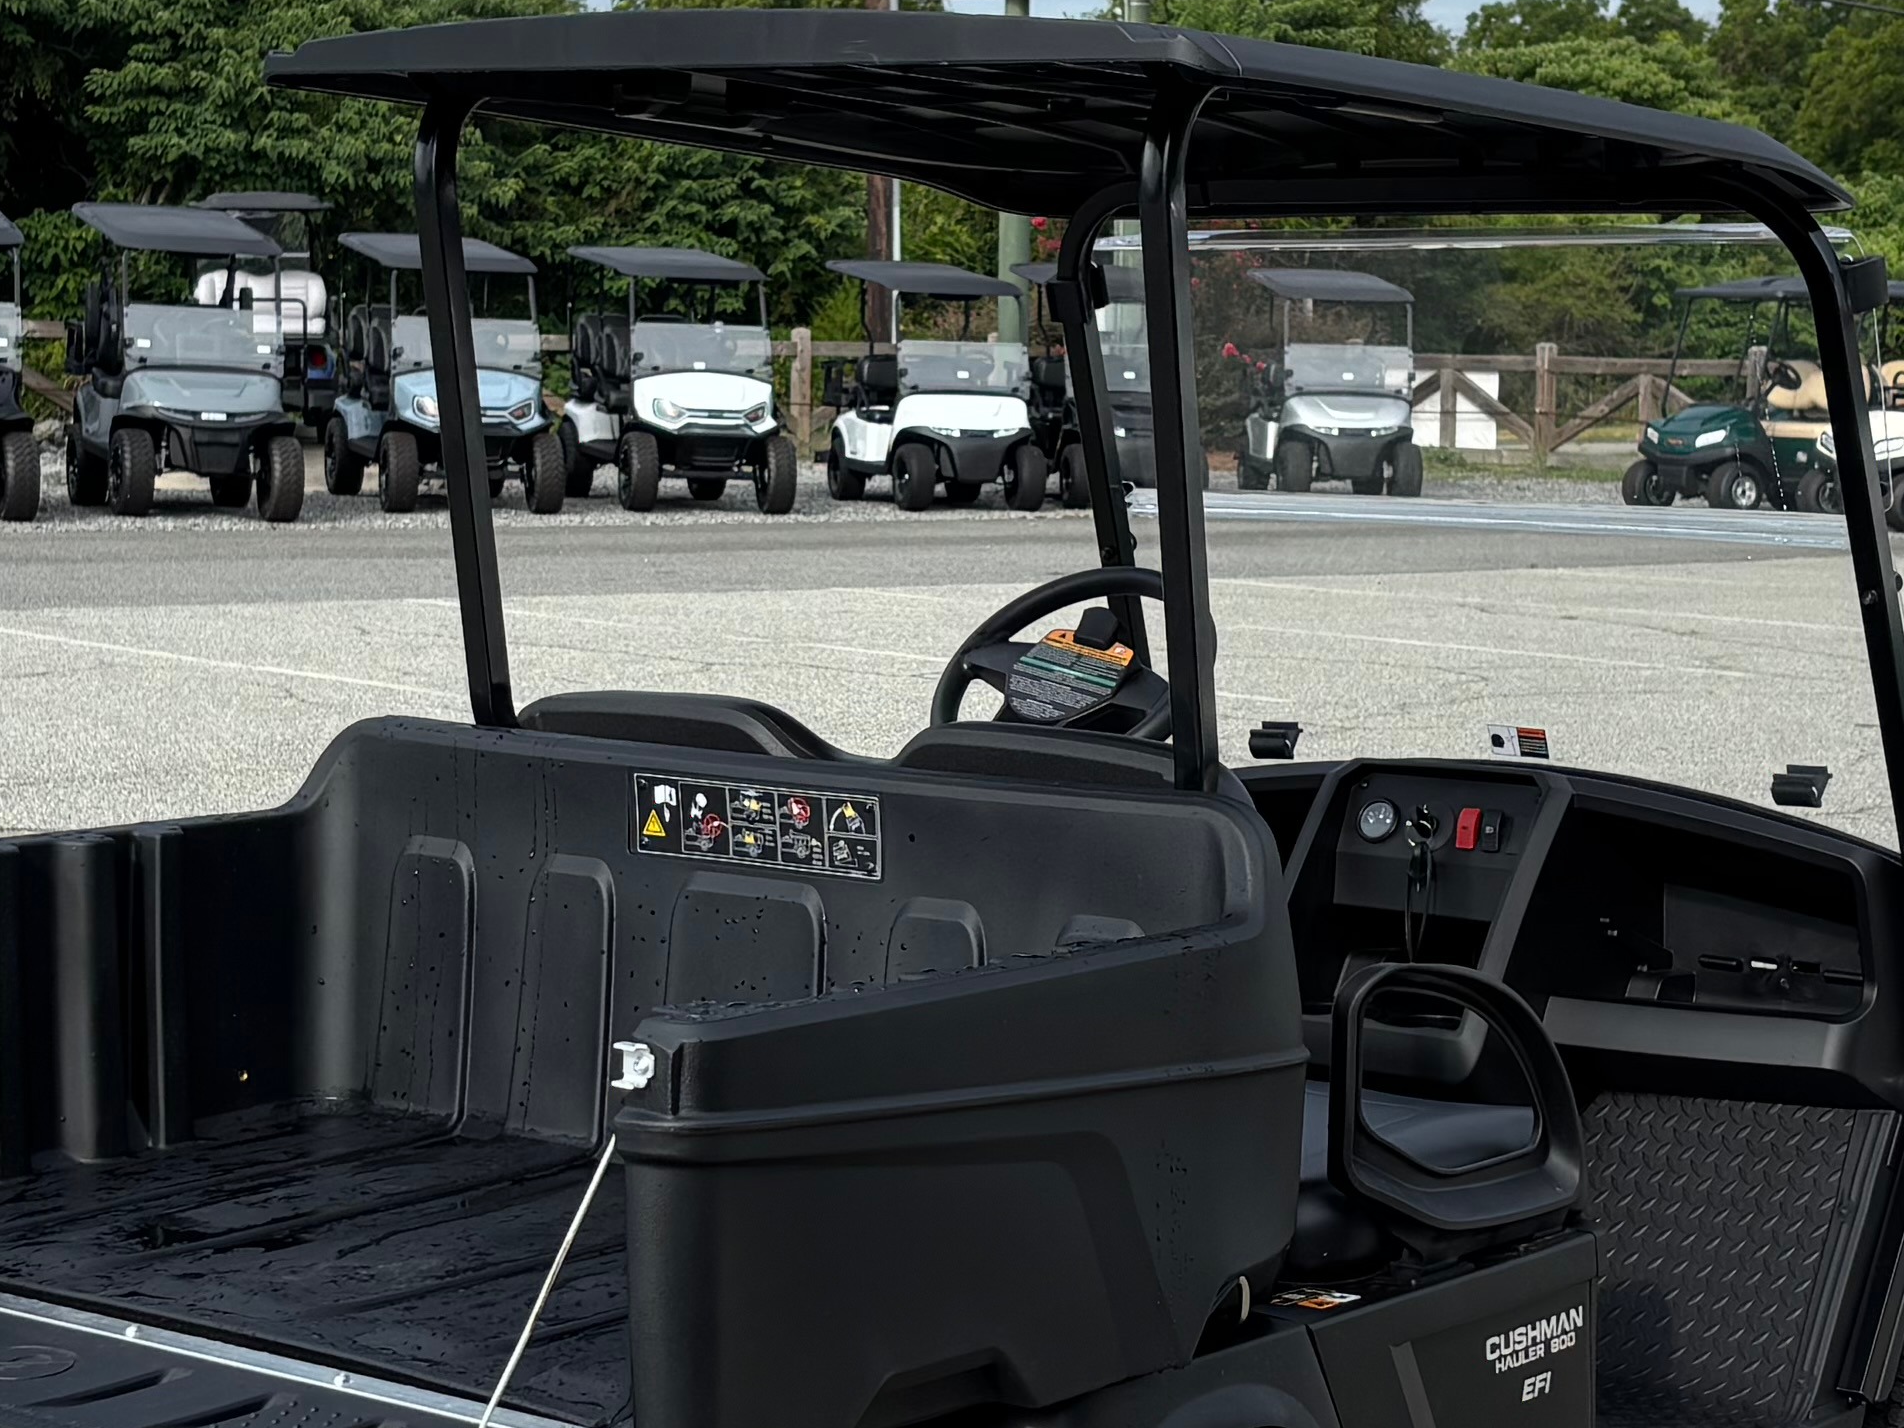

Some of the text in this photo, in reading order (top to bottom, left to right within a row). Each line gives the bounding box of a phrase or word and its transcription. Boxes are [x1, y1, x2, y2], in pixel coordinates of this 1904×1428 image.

[1485, 1305, 1584, 1361] CUSHMAN
[1495, 1331, 1576, 1374] HAULER 800
[1521, 1371, 1552, 1402] EFI
